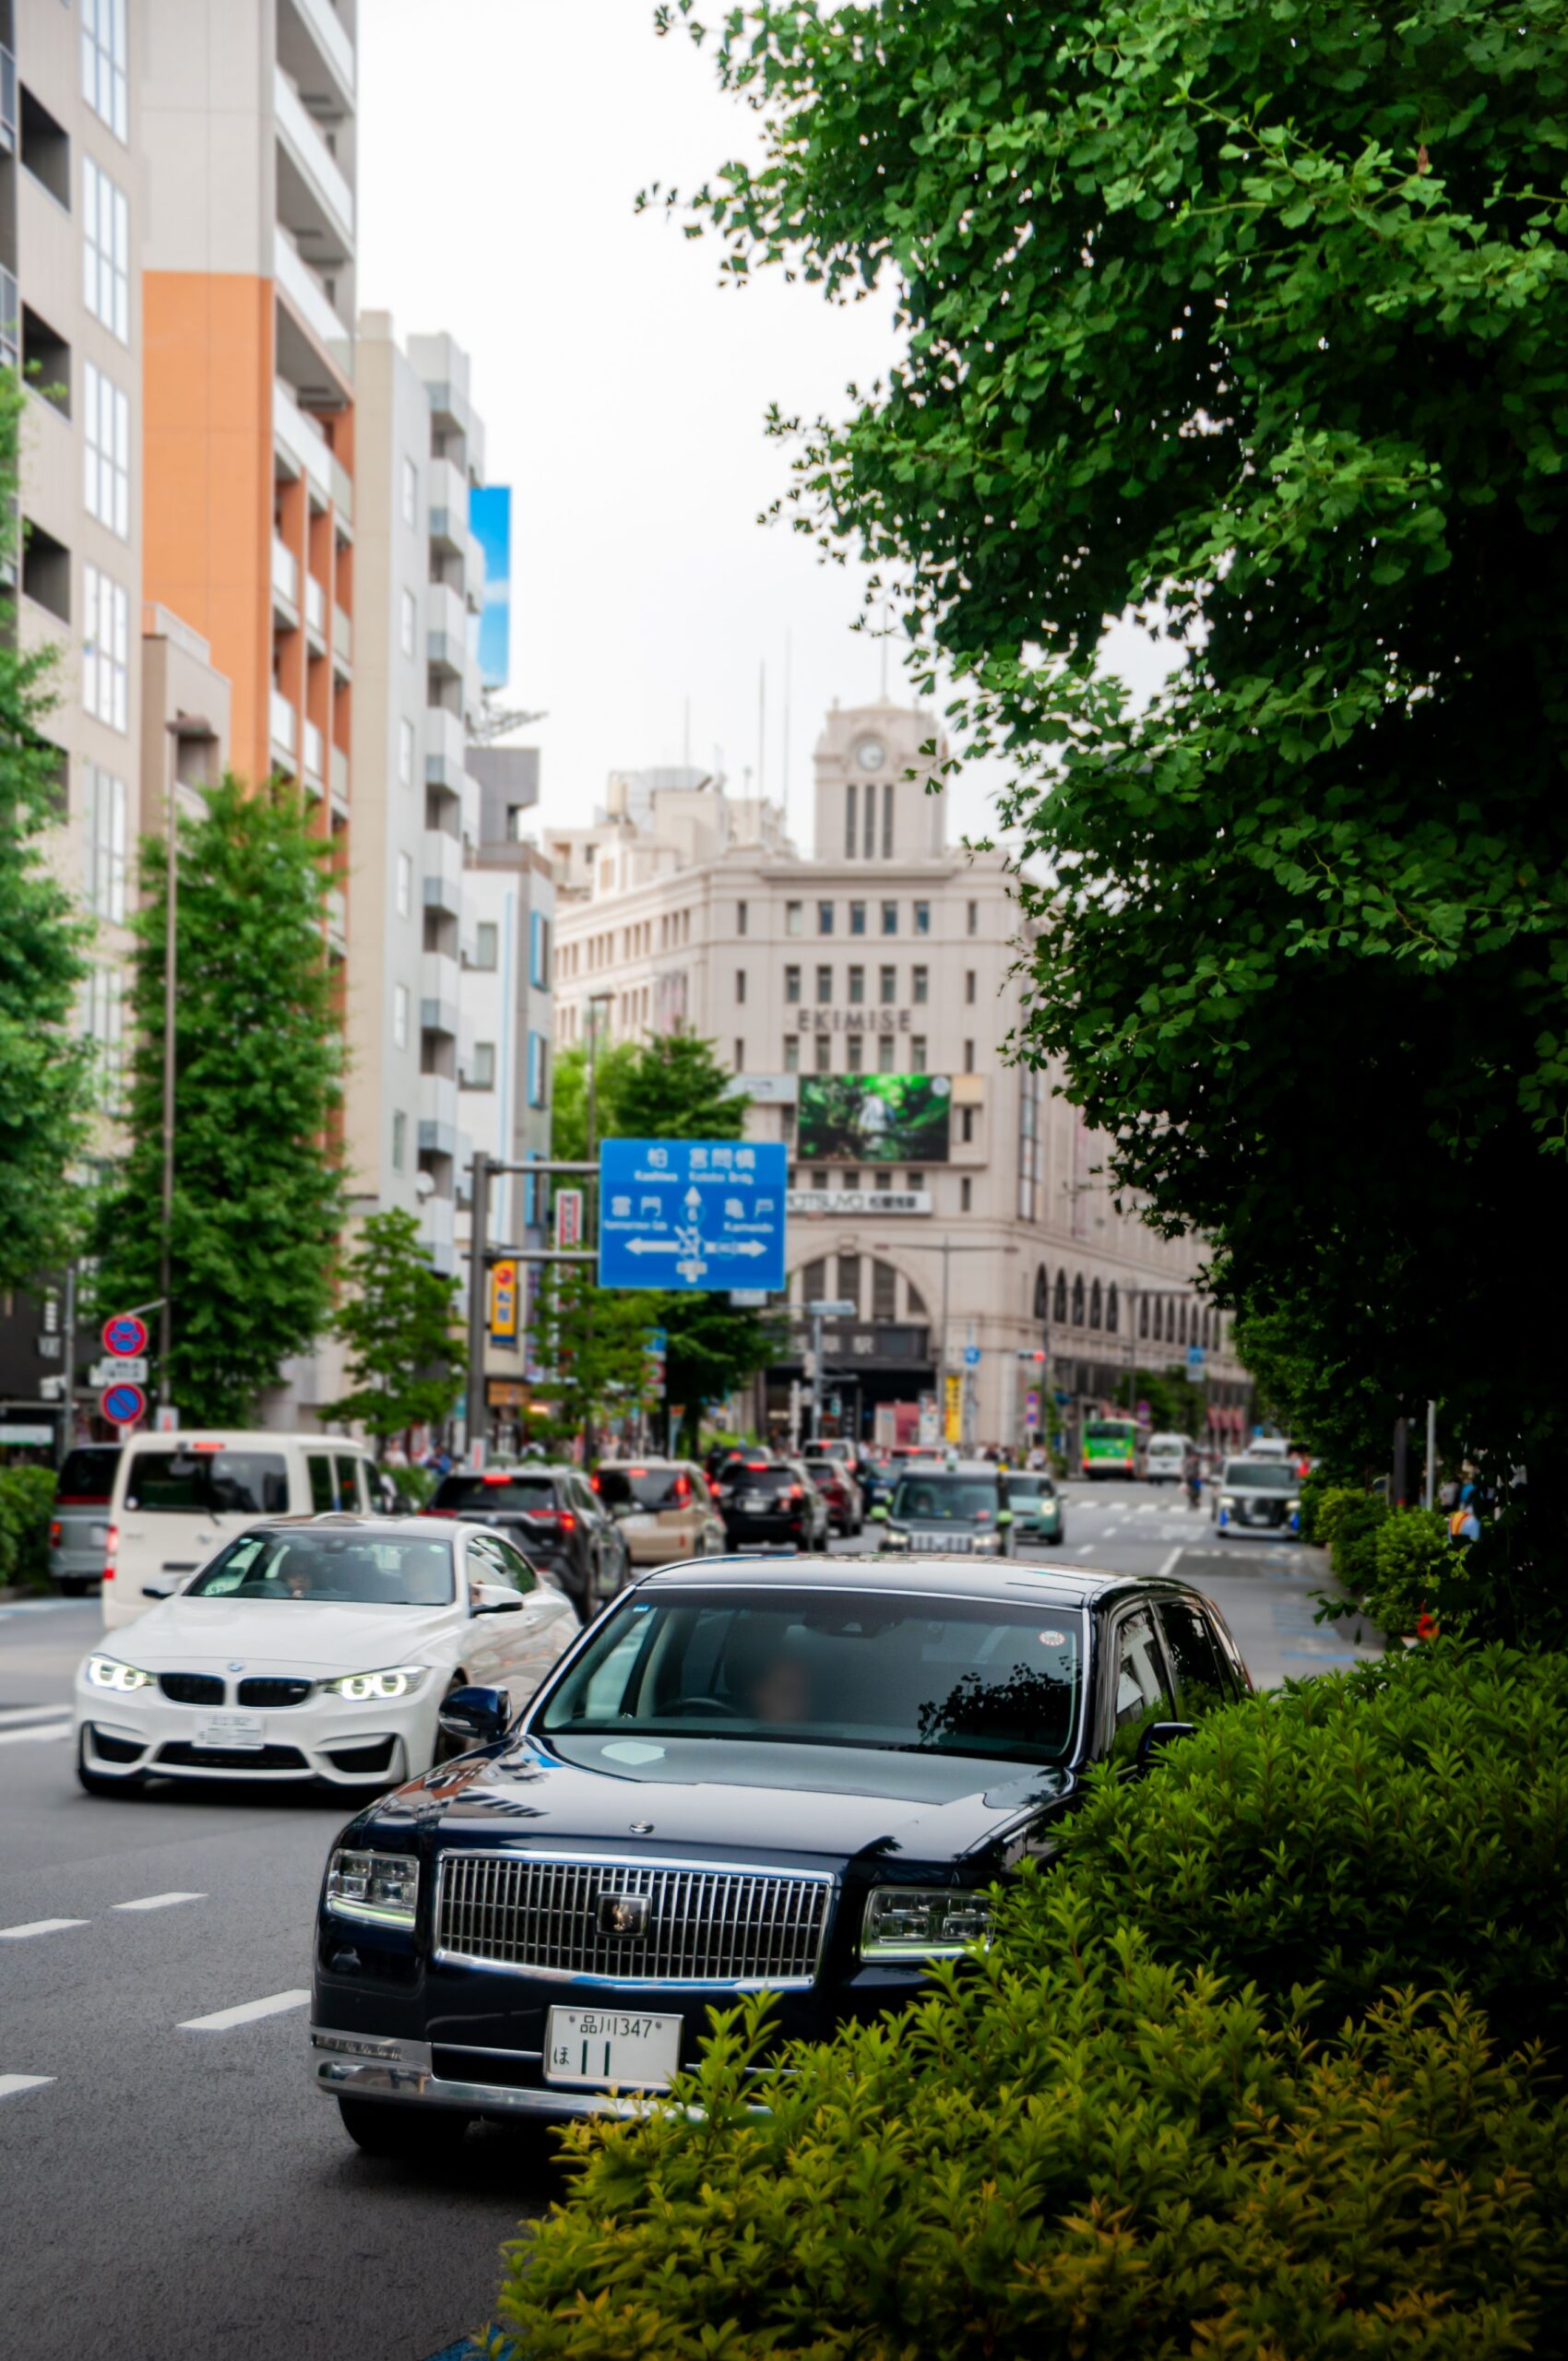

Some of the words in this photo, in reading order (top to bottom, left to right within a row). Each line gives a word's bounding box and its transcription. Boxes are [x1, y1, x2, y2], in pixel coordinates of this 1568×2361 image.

[798, 1009, 911, 1032] EKIMISE
[580, 2014, 652, 2038] 品川347
[553, 2047, 569, 2065] ほ
